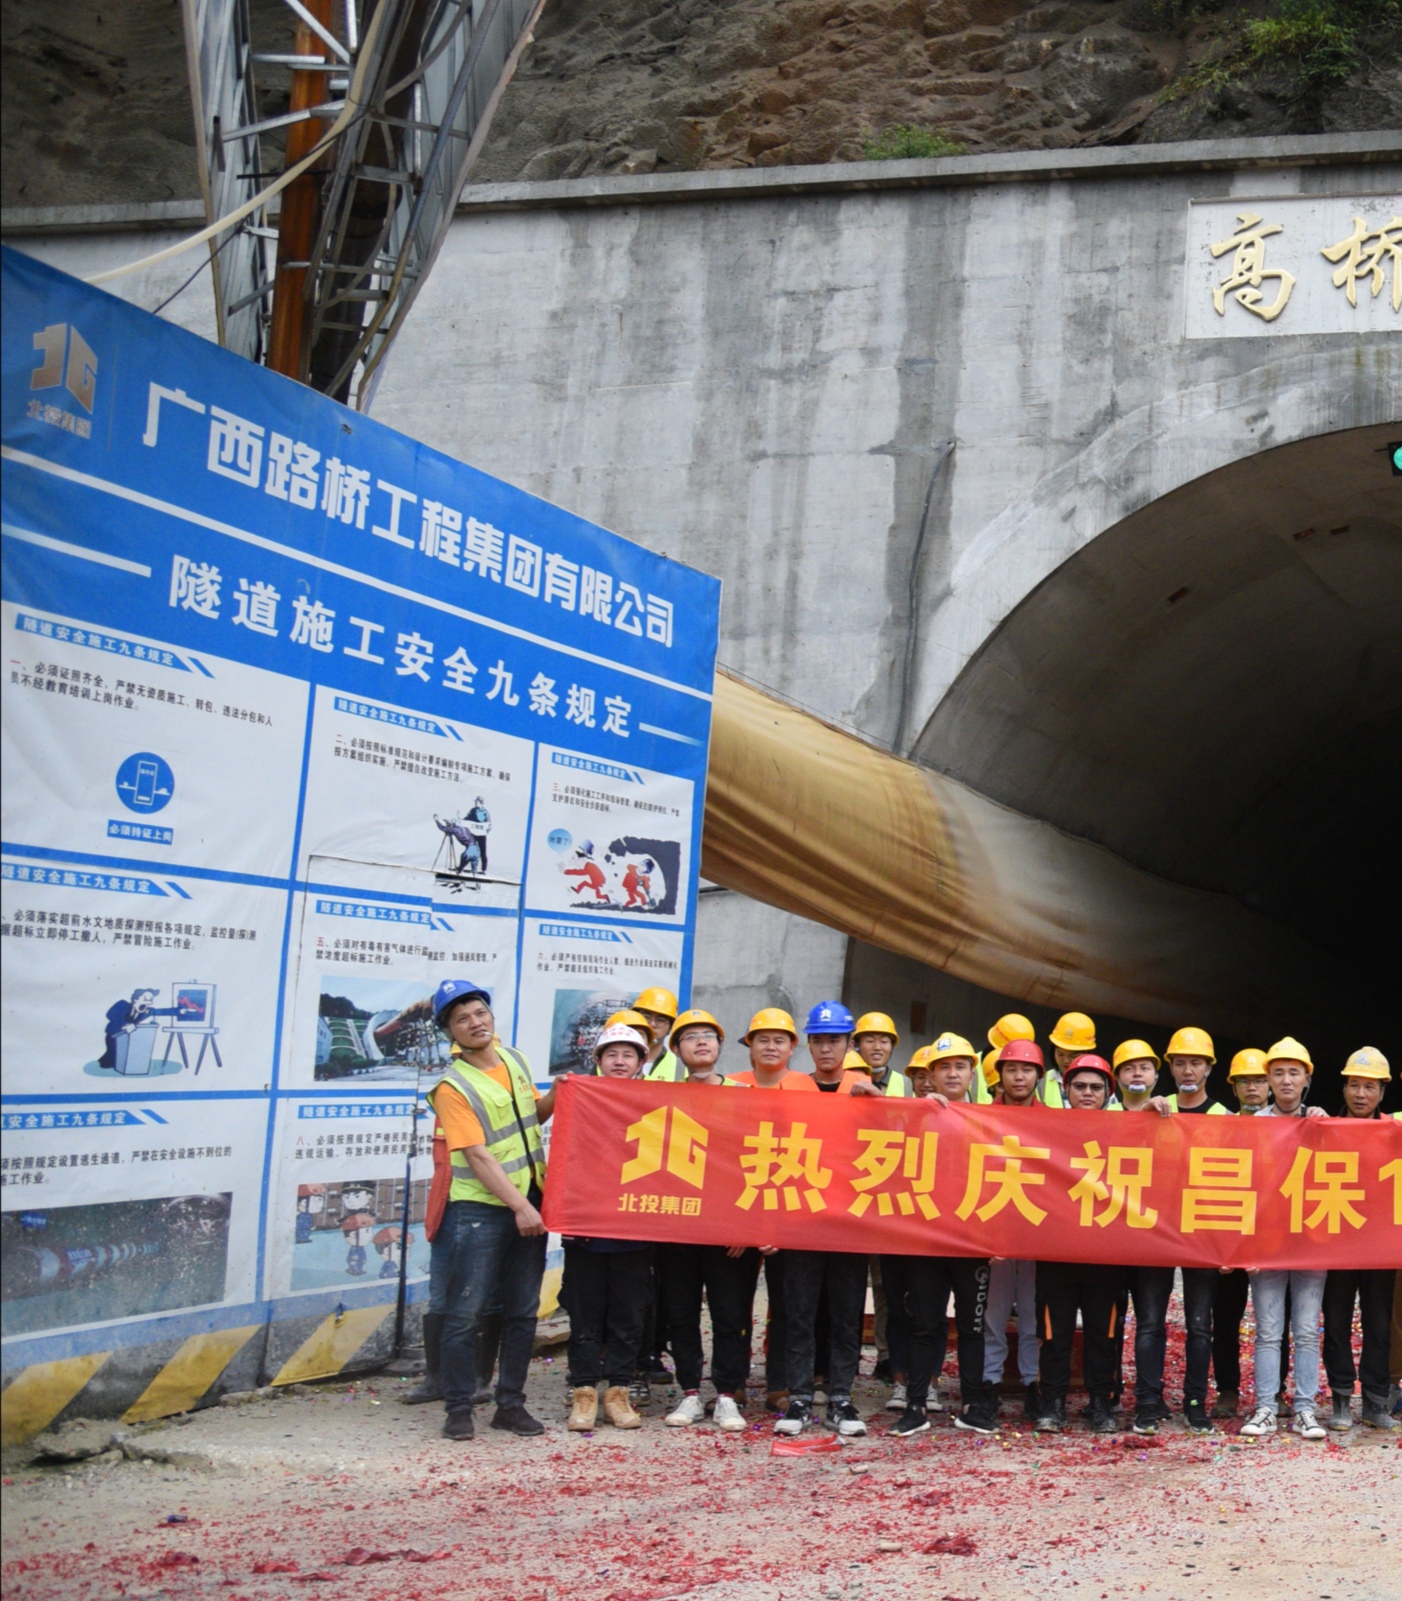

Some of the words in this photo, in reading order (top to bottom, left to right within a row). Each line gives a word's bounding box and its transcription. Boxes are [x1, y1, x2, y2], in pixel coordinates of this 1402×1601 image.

[141, 381, 675, 649] 广西路桥工程集团有限公司
[23, 615, 174, 667] 隧道安全施工九条规定
[169, 553, 632, 739] 隧道施工安全九条规定
[109, 823, 172, 843] 必须持证上岗
[1, 864, 151, 894] 隧道安全施工九条规定
[618, 1192, 702, 1217] 北投集团
